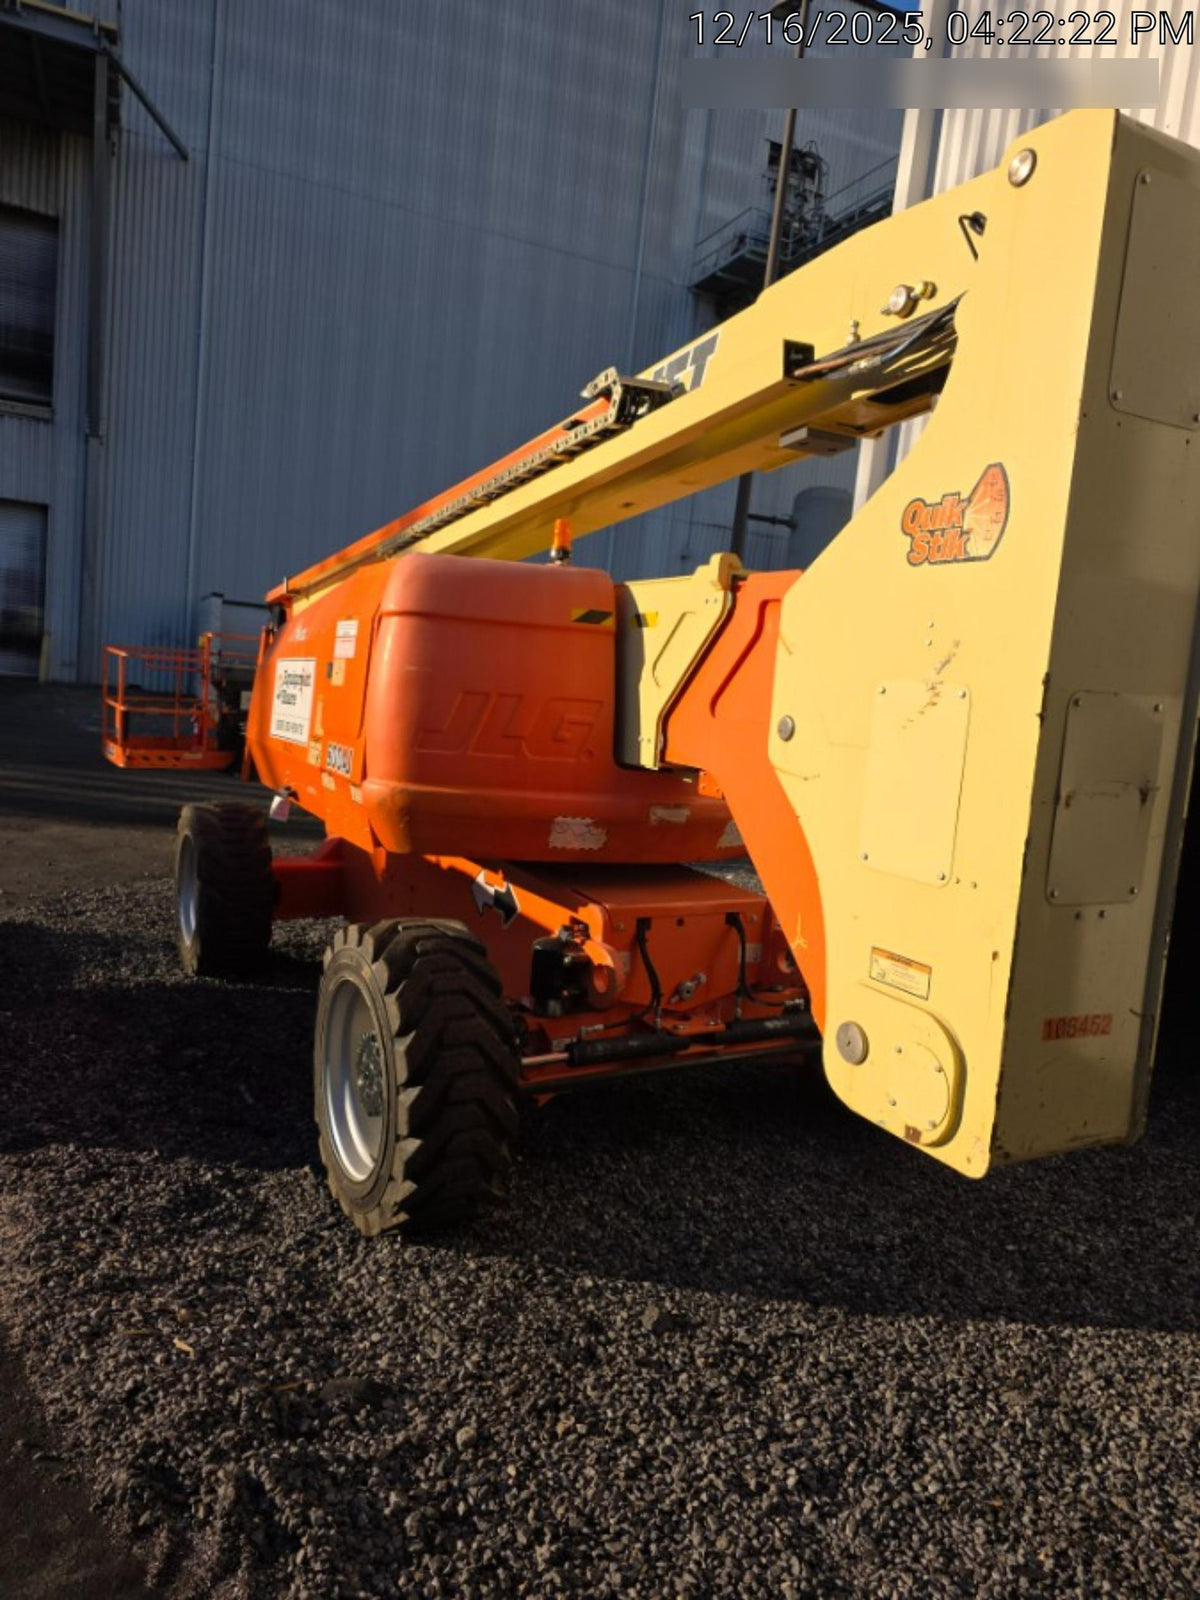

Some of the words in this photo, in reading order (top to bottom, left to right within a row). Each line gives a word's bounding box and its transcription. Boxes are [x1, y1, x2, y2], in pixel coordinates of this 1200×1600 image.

[902, 493, 966, 534] Quik
[907, 528, 968, 566] Stik
[415, 690, 605, 763] JLG
